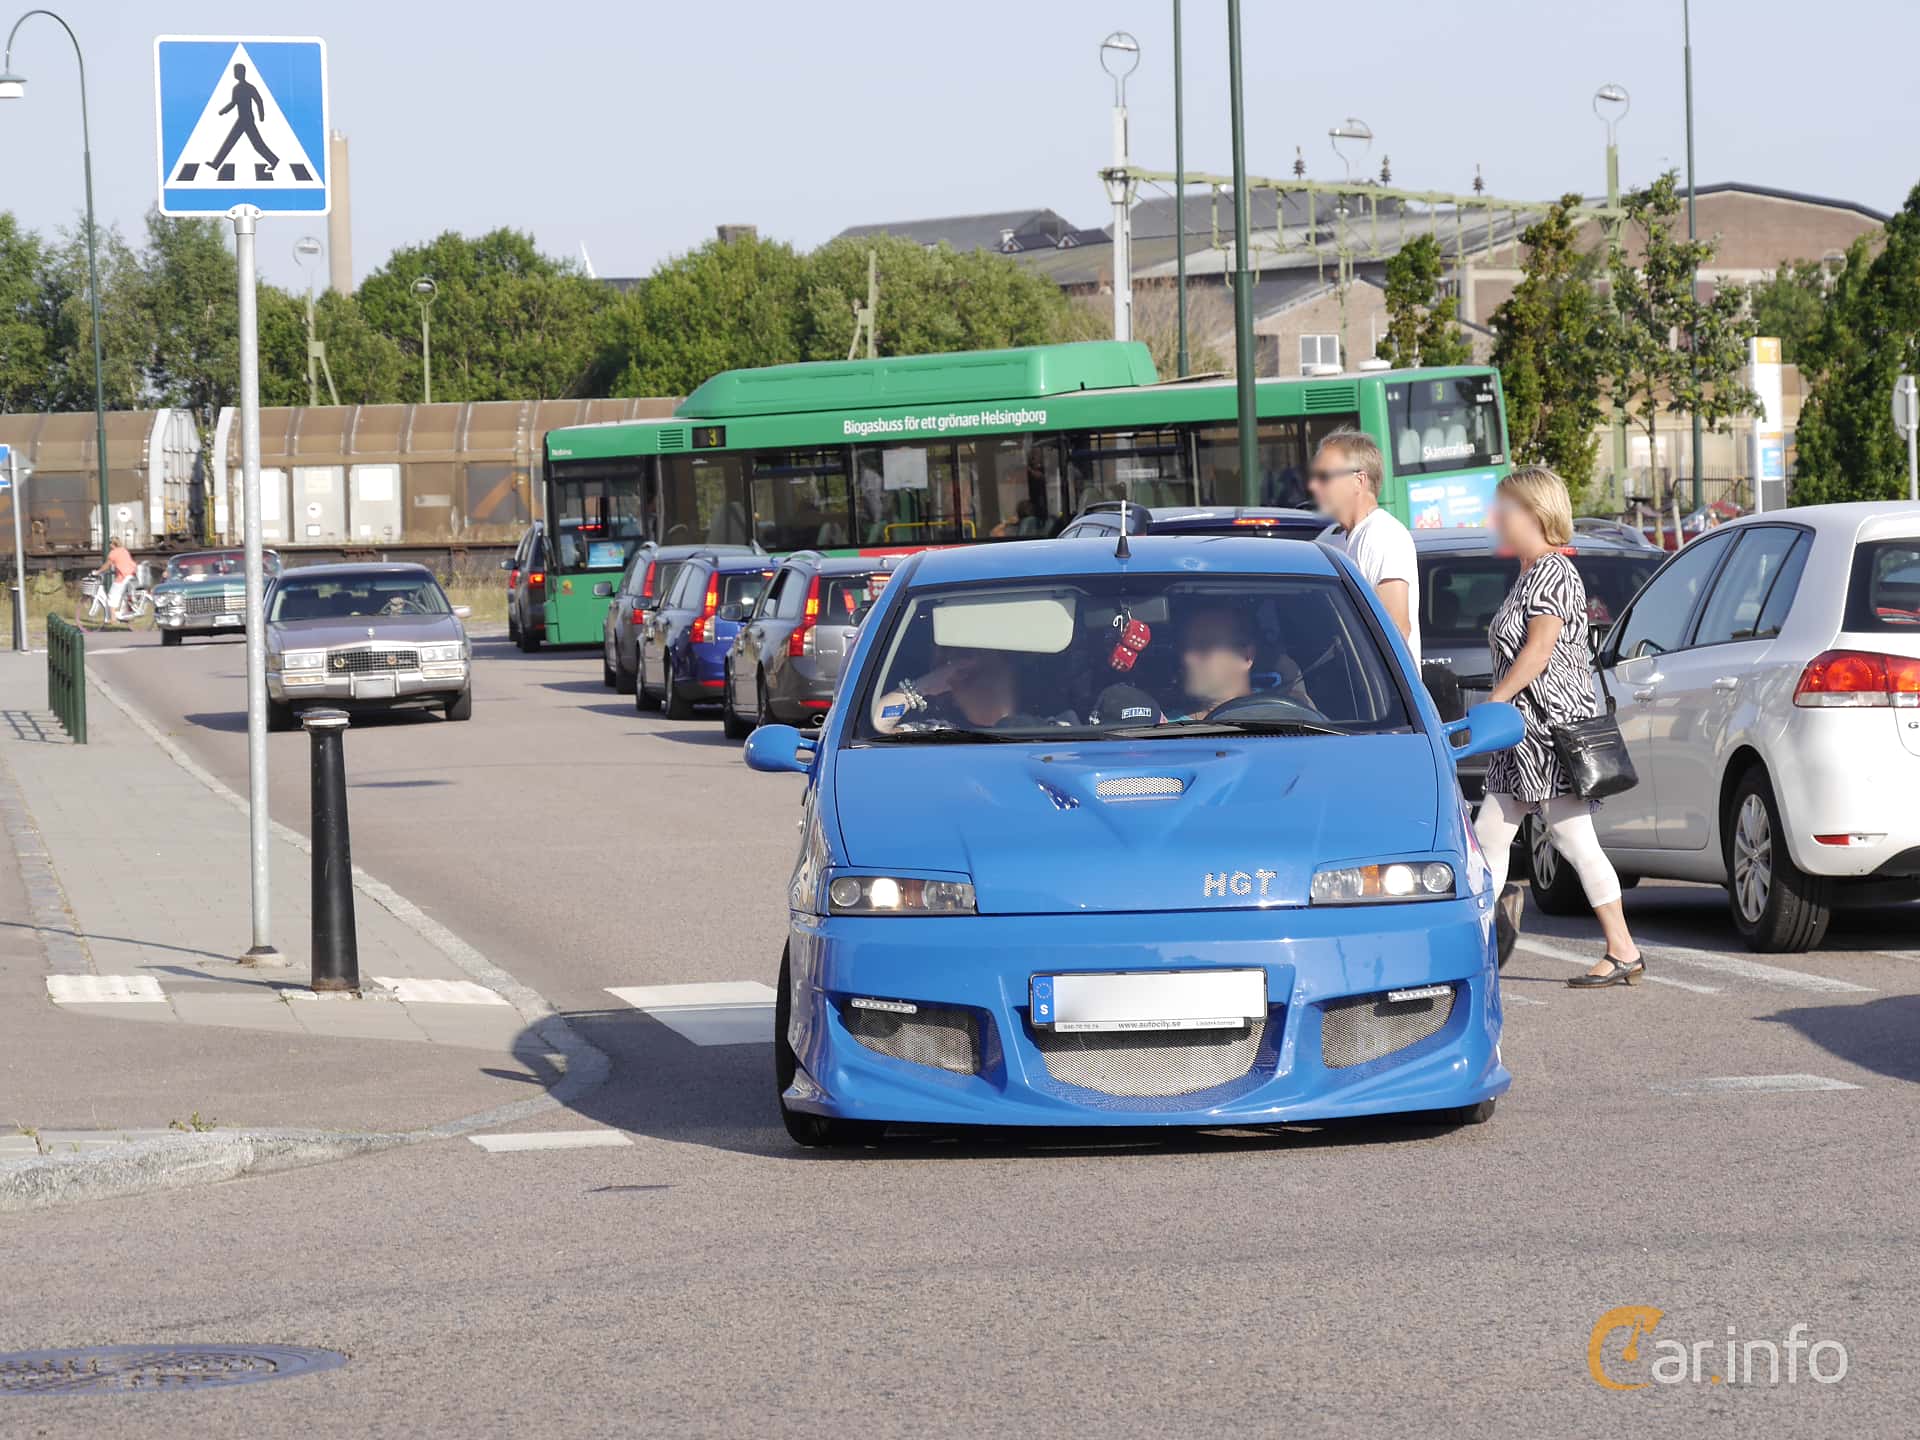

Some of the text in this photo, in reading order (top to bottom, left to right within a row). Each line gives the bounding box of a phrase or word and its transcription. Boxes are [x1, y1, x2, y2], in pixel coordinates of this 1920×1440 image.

[843, 408, 1047, 436] Biogasbuss för ett grönare Helsingborg
[707, 428, 718, 447] 3
[1203, 868, 1278, 897] HGT
[1040, 1004, 1048, 1015] S
[1117, 1019, 1182, 1030] www.autocity.se
